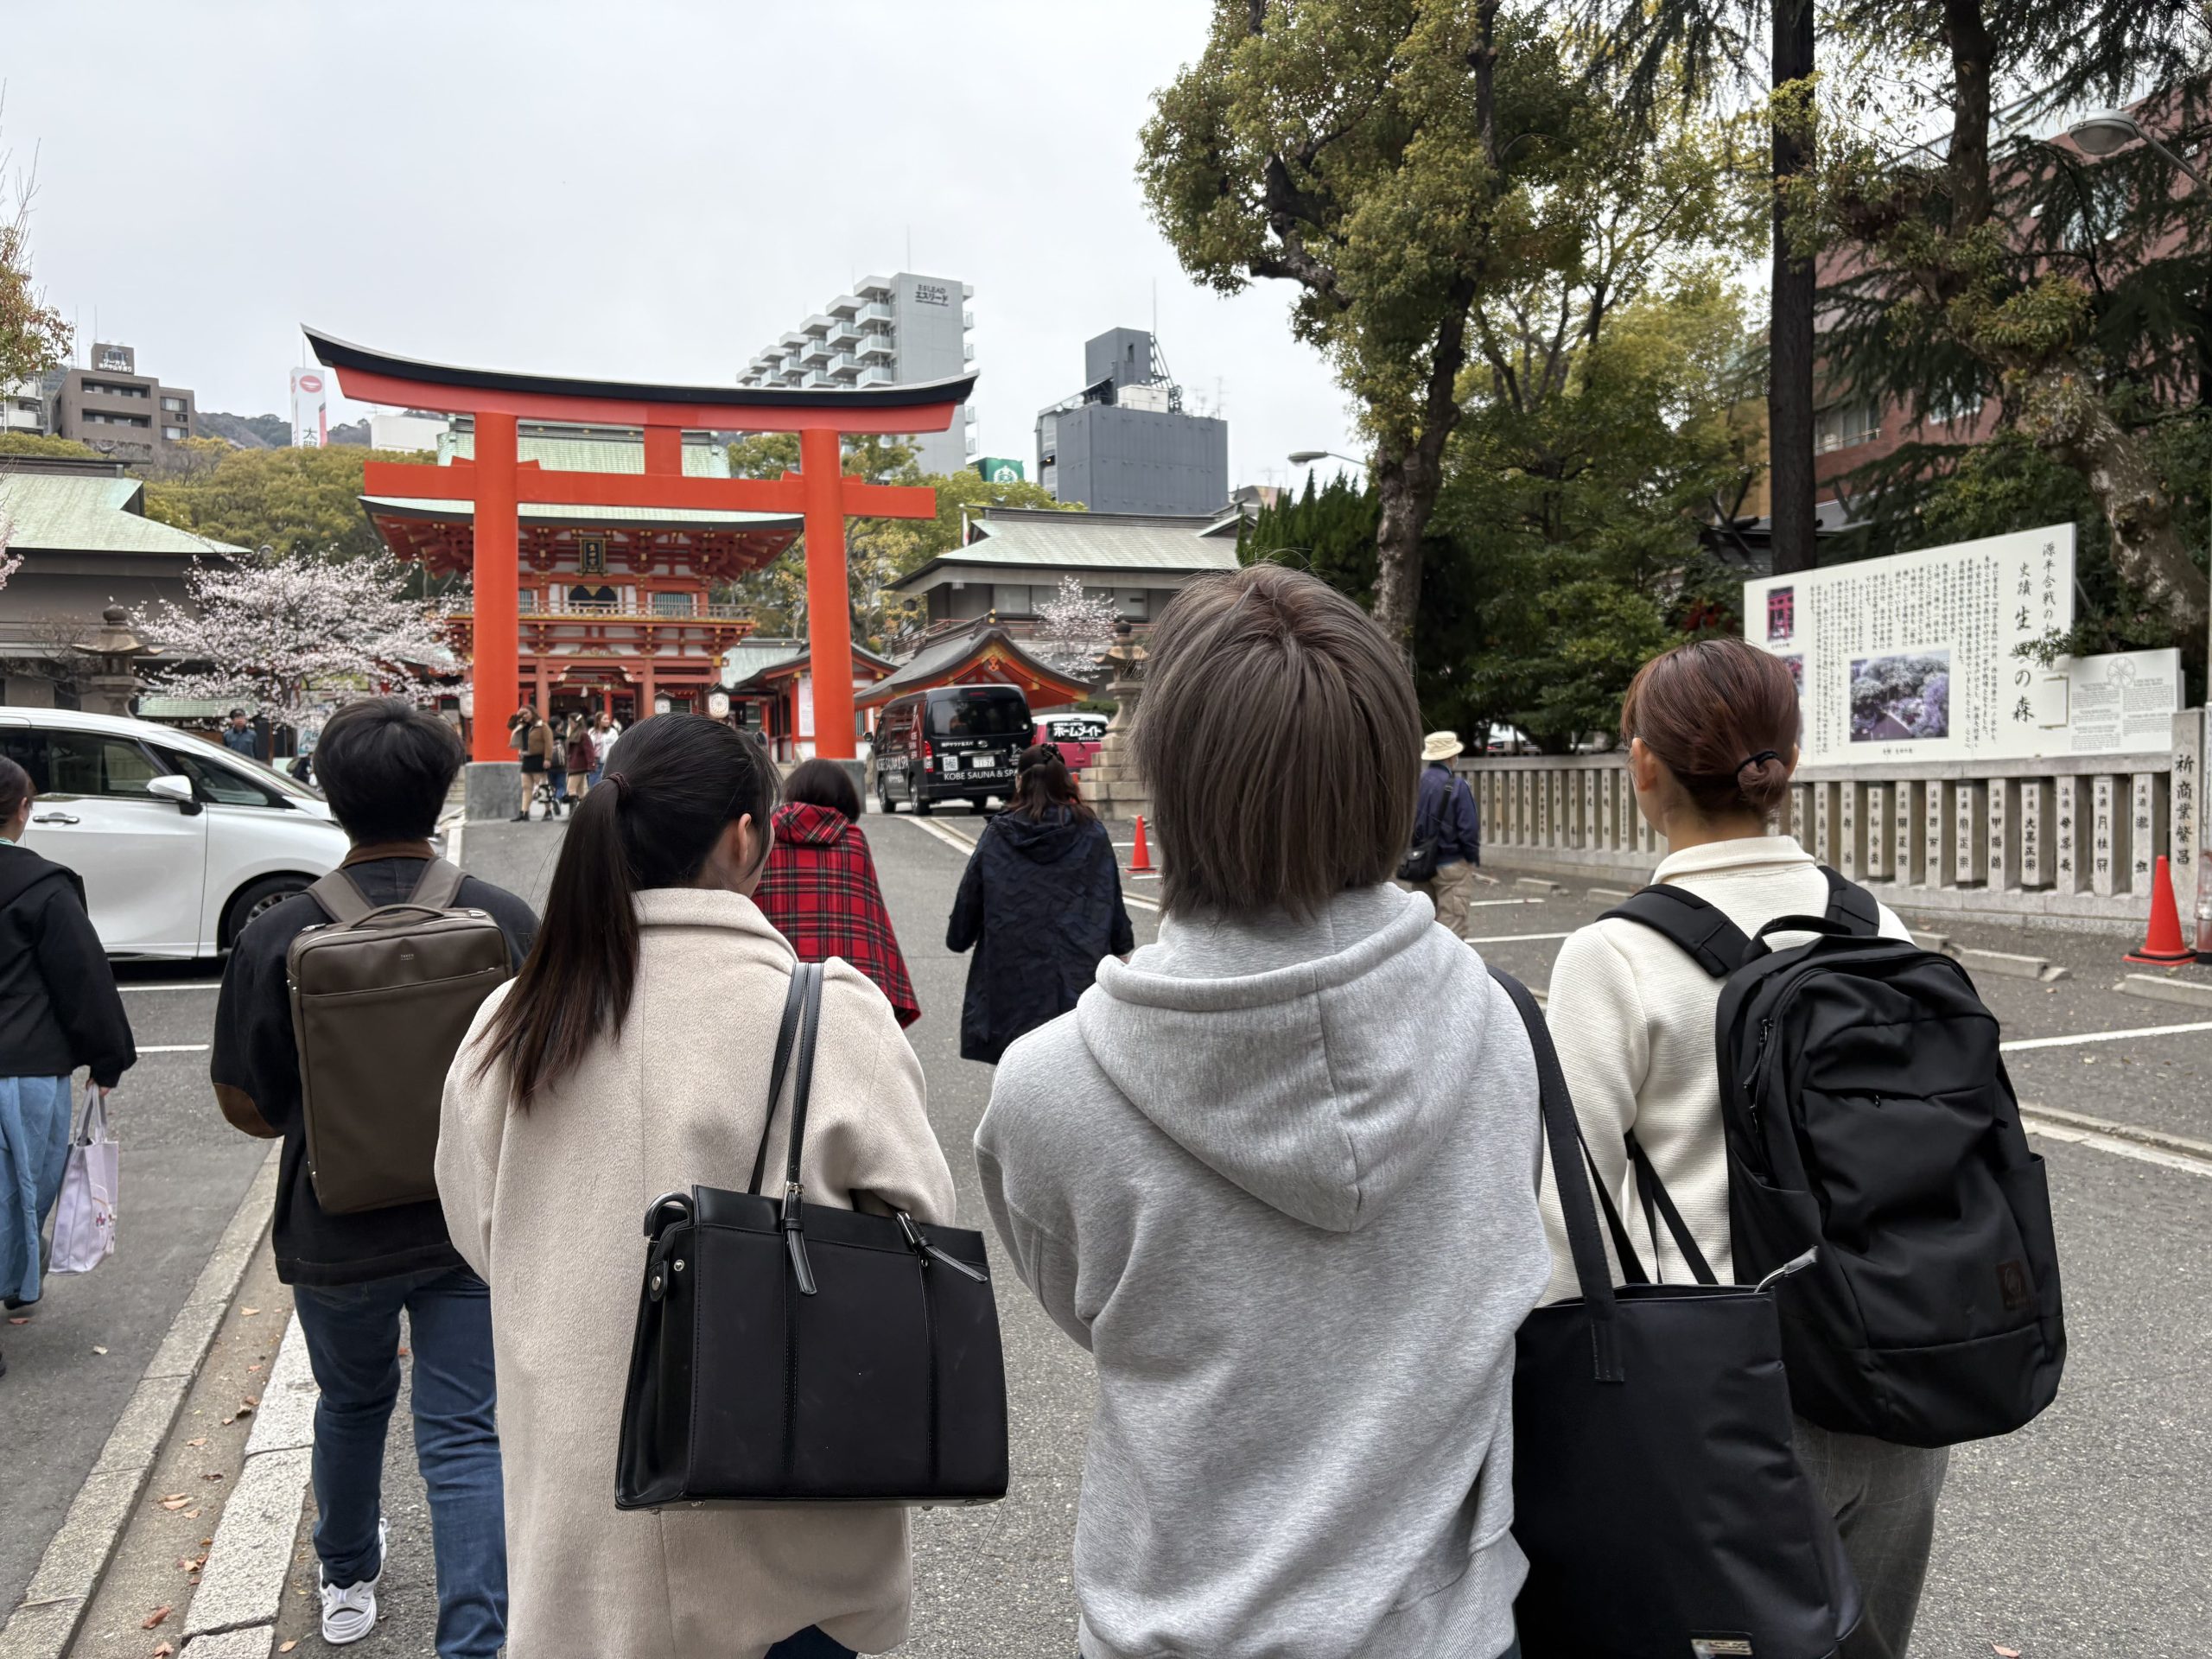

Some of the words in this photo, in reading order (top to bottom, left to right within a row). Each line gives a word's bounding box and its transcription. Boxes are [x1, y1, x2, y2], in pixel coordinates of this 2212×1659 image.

[2012, 605, 2035, 723] 生の森
[1053, 726, 1103, 737] ホームメイト
[944, 772, 965, 780] KOBE
[968, 770, 995, 779] SAUNA
[996, 769, 1003, 778] &
